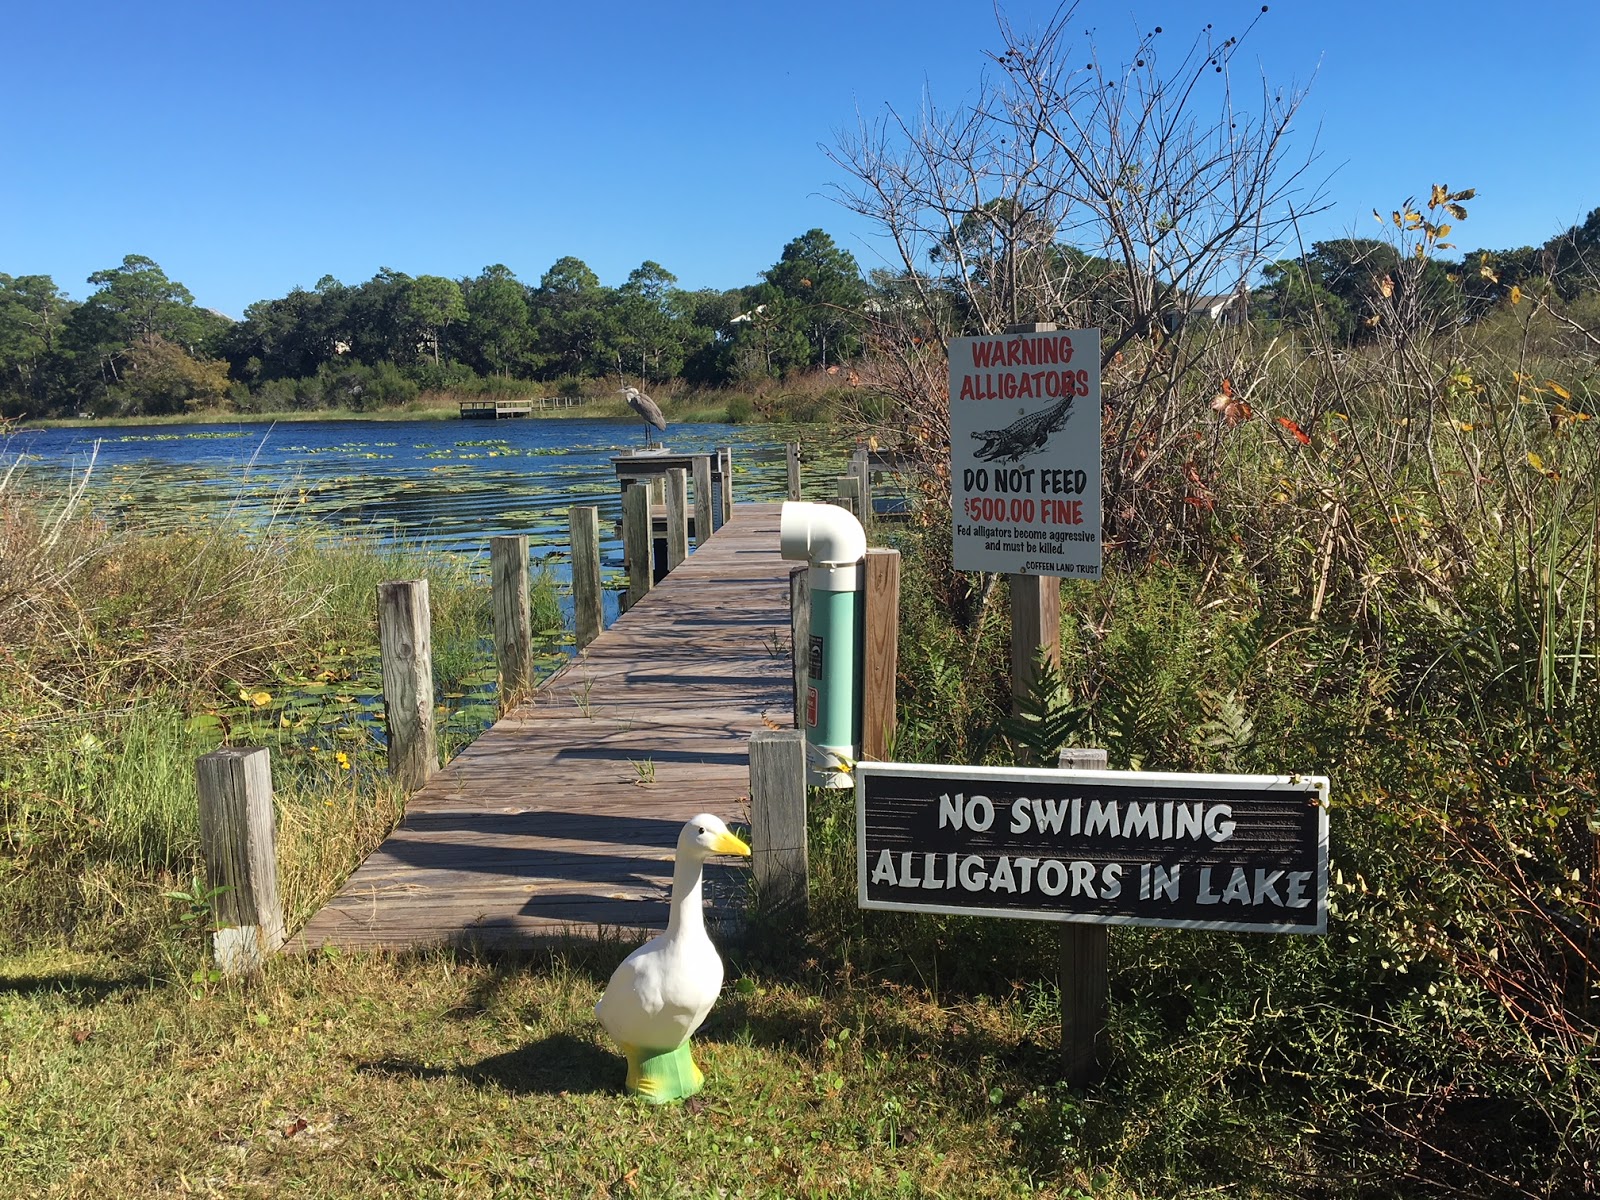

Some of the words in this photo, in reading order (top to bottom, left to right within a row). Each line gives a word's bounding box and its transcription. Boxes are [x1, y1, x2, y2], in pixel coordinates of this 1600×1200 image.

[972, 336, 1074, 368] WARNING
[960, 369, 1089, 400] ALLIGATORS
[964, 468, 989, 492] DO
[995, 469, 1035, 493] NOT
[1041, 469, 1087, 494] FEED
[964, 498, 1035, 523] $500.00
[1041, 500, 1084, 525] FINE
[957, 525, 971, 536] Fed
[974, 527, 1011, 538] alligators
[1014, 528, 1046, 539] become
[1049, 531, 1095, 542] aggressive
[985, 541, 1000, 550] and
[1003, 542, 1024, 552] must
[1027, 543, 1036, 552] be
[1039, 543, 1064, 554] killed.
[1026, 561, 1054, 571] COFFEEN
[1056, 564, 1074, 572] LAND
[1076, 565, 1098, 574] TRUST
[938, 793, 995, 832] NO
[1010, 797, 1236, 842] SWIMMING
[871, 849, 1122, 900] ALLIGATORS
[1139, 863, 1181, 901] IN
[1197, 867, 1313, 908] LAKE
